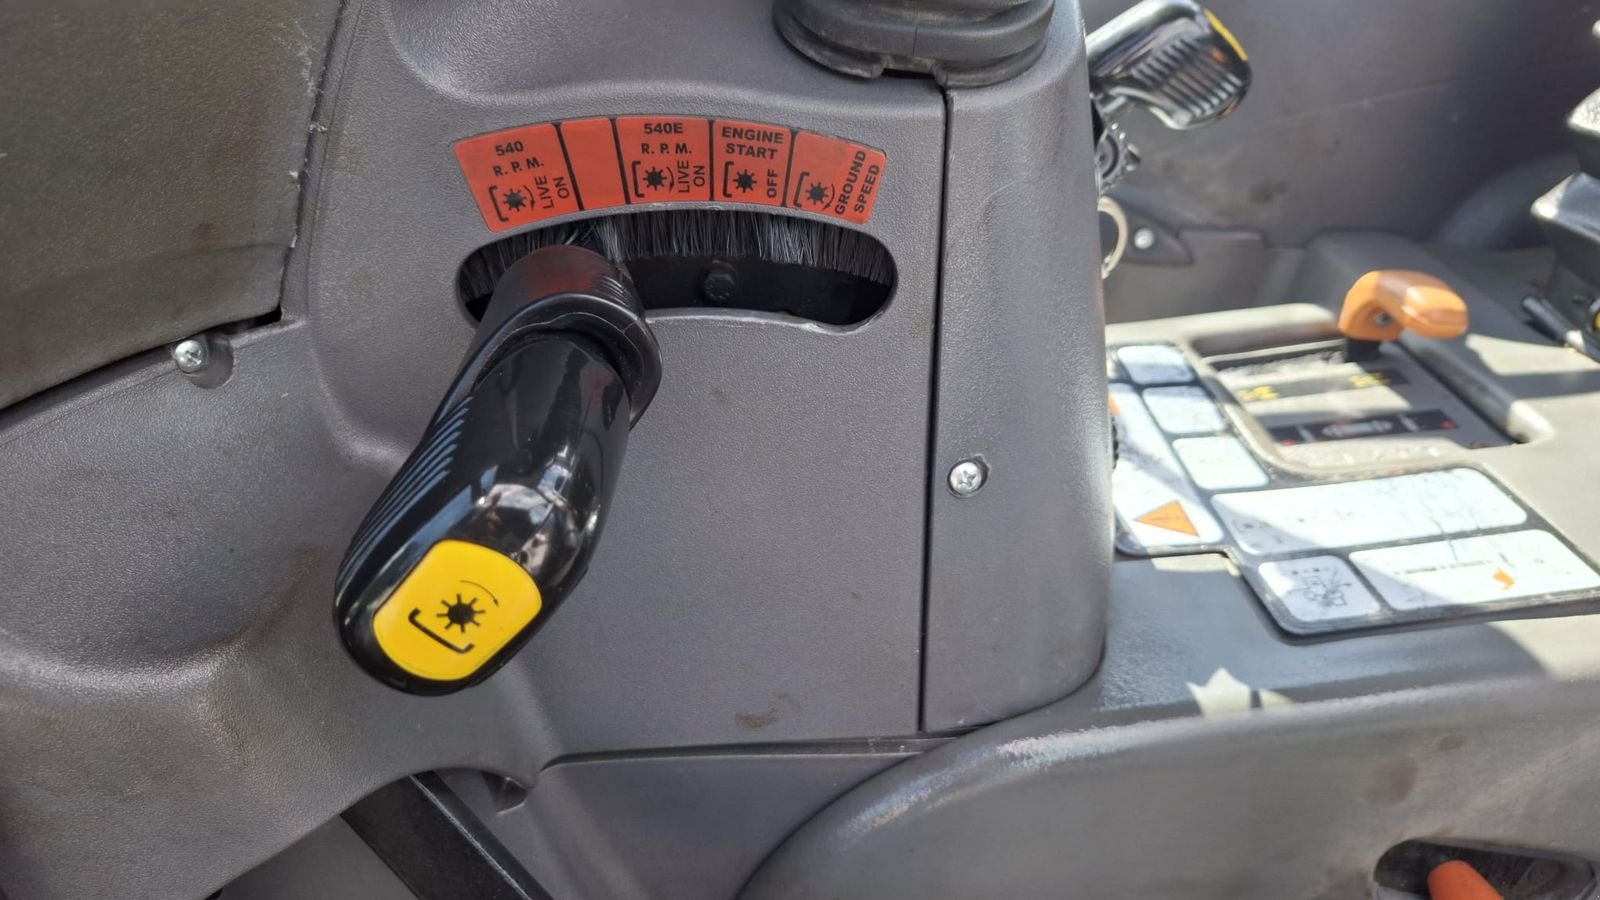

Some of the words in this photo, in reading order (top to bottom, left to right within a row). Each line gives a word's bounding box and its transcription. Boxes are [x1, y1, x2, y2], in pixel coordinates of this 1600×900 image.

[644, 122, 683, 134] 540E
[722, 126, 784, 144] ENGINE
[495, 140, 524, 156] 540
[726, 142, 778, 160] START
[553, 176, 570, 199] ON
[677, 160, 690, 193] LIVE
[693, 165, 705, 187] ON
[766, 169, 778, 199] OFF
[834, 150, 866, 215] GROUND
[534, 175, 554, 209] LIVE
[853, 164, 880, 214] SPEED
